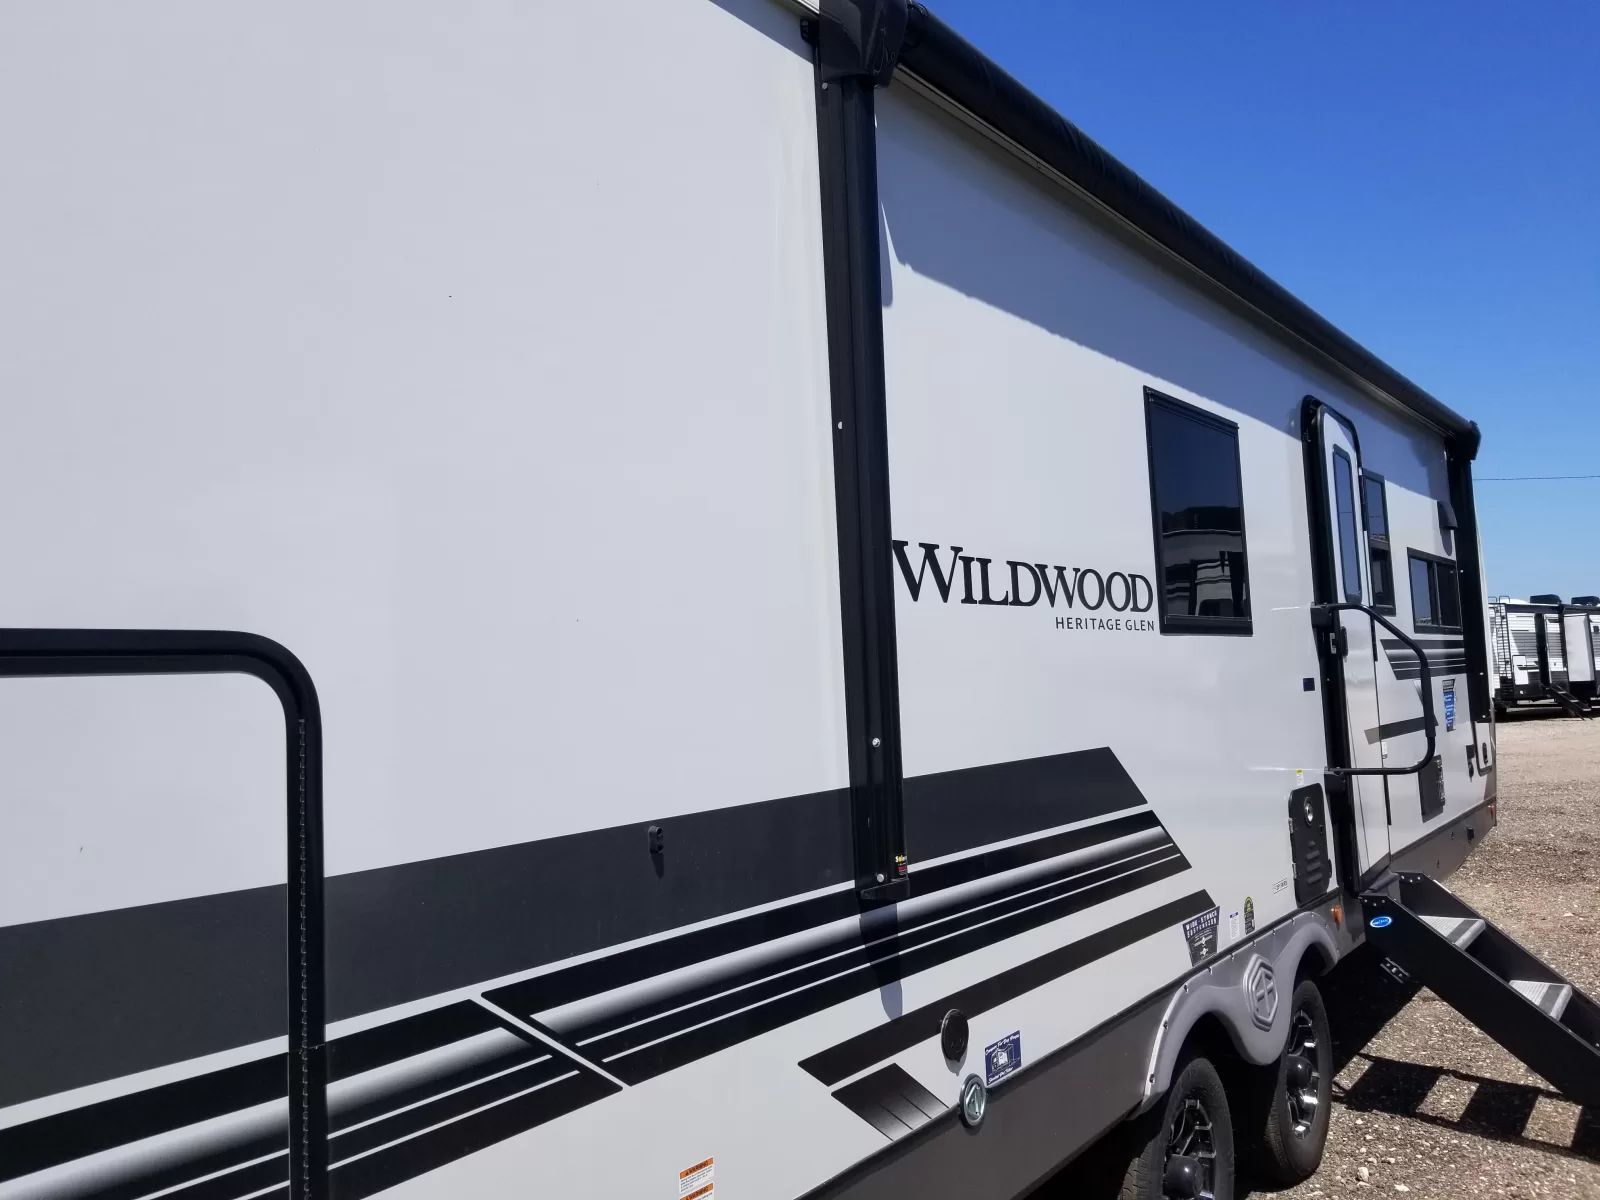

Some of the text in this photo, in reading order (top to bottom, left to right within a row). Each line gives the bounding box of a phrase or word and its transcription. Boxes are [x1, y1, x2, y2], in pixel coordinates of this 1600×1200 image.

[892, 539, 1154, 613] WILDWOOD
[1055, 616, 1155, 632] HERITAGE GLEN
